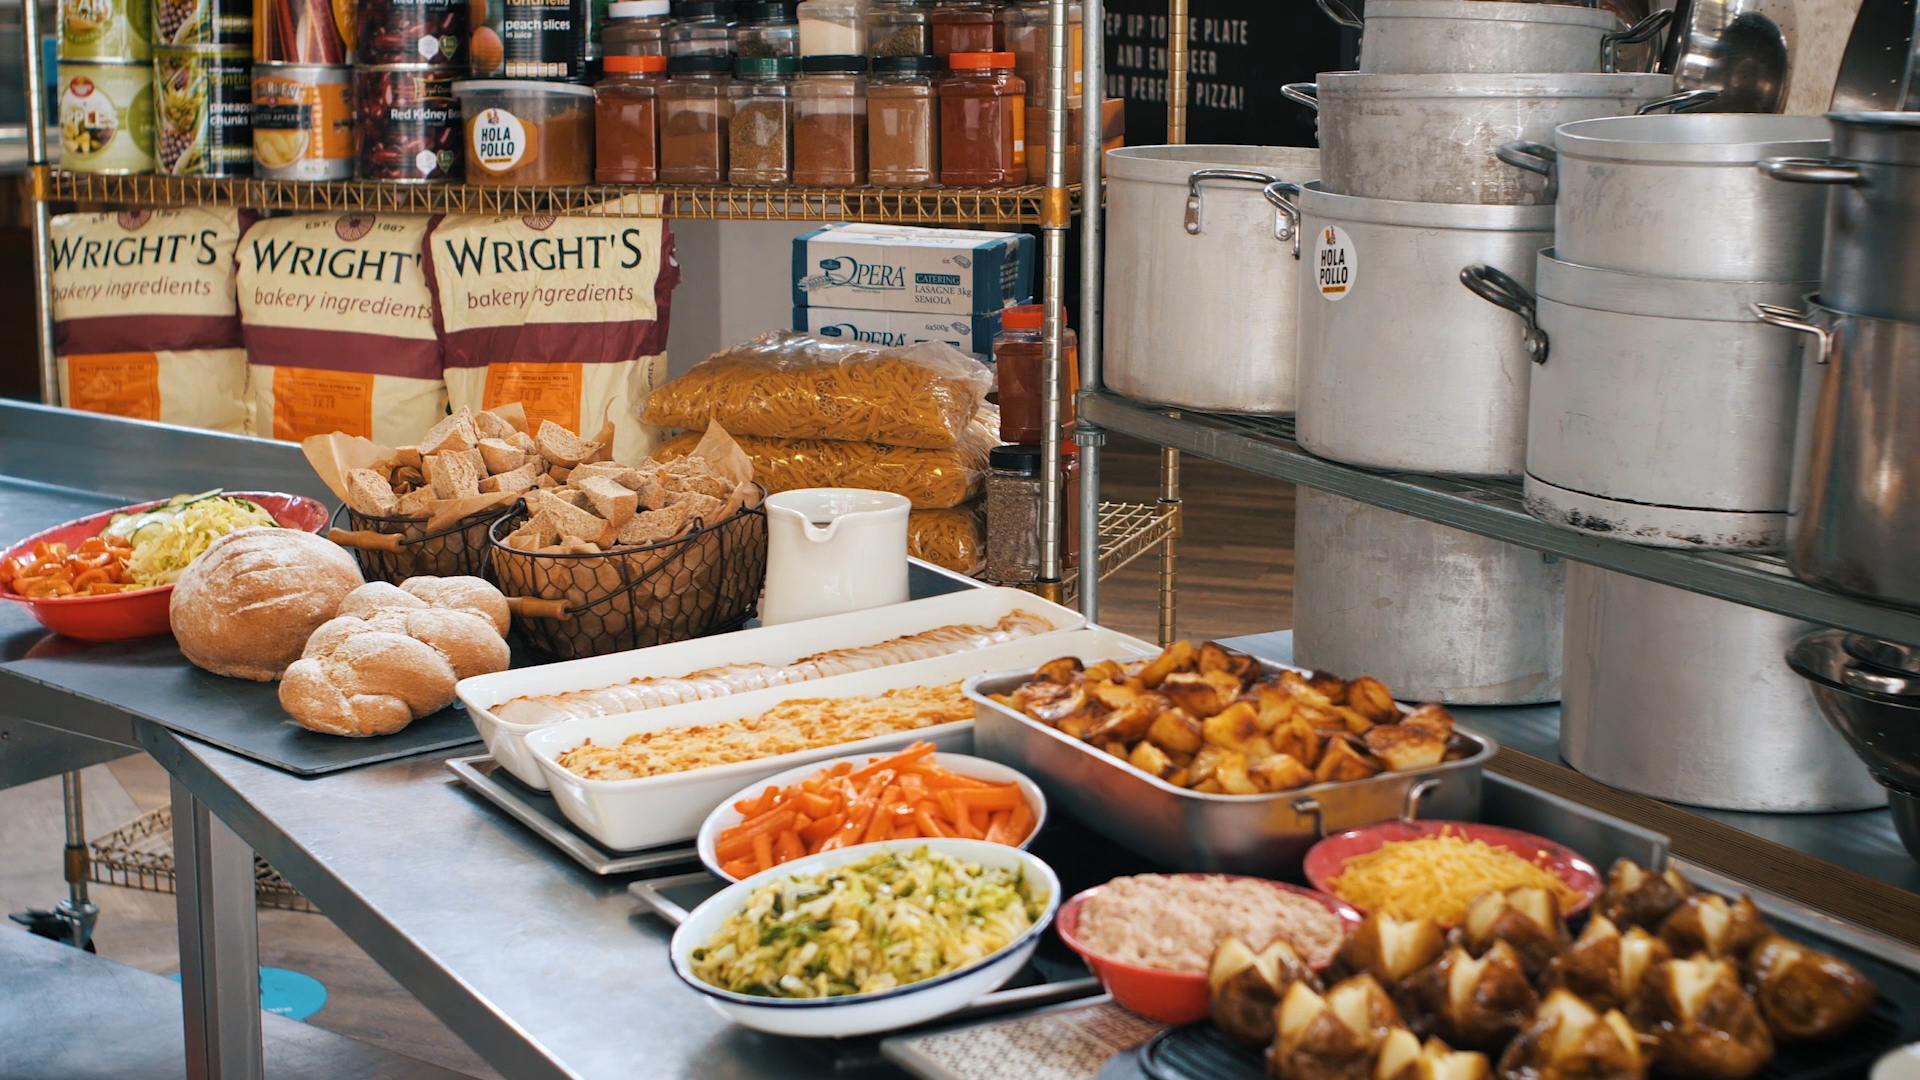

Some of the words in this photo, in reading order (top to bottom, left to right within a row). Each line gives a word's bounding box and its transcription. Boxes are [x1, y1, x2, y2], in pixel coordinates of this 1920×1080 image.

[505, 19, 542, 32] peach
[543, 19, 571, 31] slices
[1105, 12, 1121, 37] EP
[1127, 14, 1143, 38] UP
[1149, 15, 1166, 40] TO
[1204, 18, 1248, 46] PLATE
[1117, 43, 1142, 69] AND
[1149, 46, 1217, 75] ENEER
[1196, 82, 1244, 111] PIZZA!
[210, 103, 253, 114] pineapp
[391, 108, 411, 119] Red
[413, 108, 447, 121] Kidney
[210, 114, 249, 126] chunks
[481, 126, 511, 142] HOLA
[480, 141, 515, 157] POLLO
[377, 222, 405, 233] 1867
[51, 230, 218, 272] WRIGHT'S
[445, 228, 642, 278] WRIGHT'S
[1321, 248, 1345, 267] HOLA
[253, 238, 426, 286] WRIGHT'
[941, 257, 950, 265] 6x
[915, 274, 960, 286] CATERING
[1319, 266, 1348, 286] POLLO
[52, 282, 103, 302] bakery
[105, 276, 212, 300] ingredients
[467, 288, 530, 309] bakery
[532, 282, 634, 306] ngredients
[914, 284, 955, 297] LASAGNE
[957, 287, 973, 299] 3kg
[255, 287, 316, 312] bakery
[320, 291, 432, 319] ingredients
[914, 295, 951, 306] SEMOLA
[925, 324, 949, 333] 6x500g
